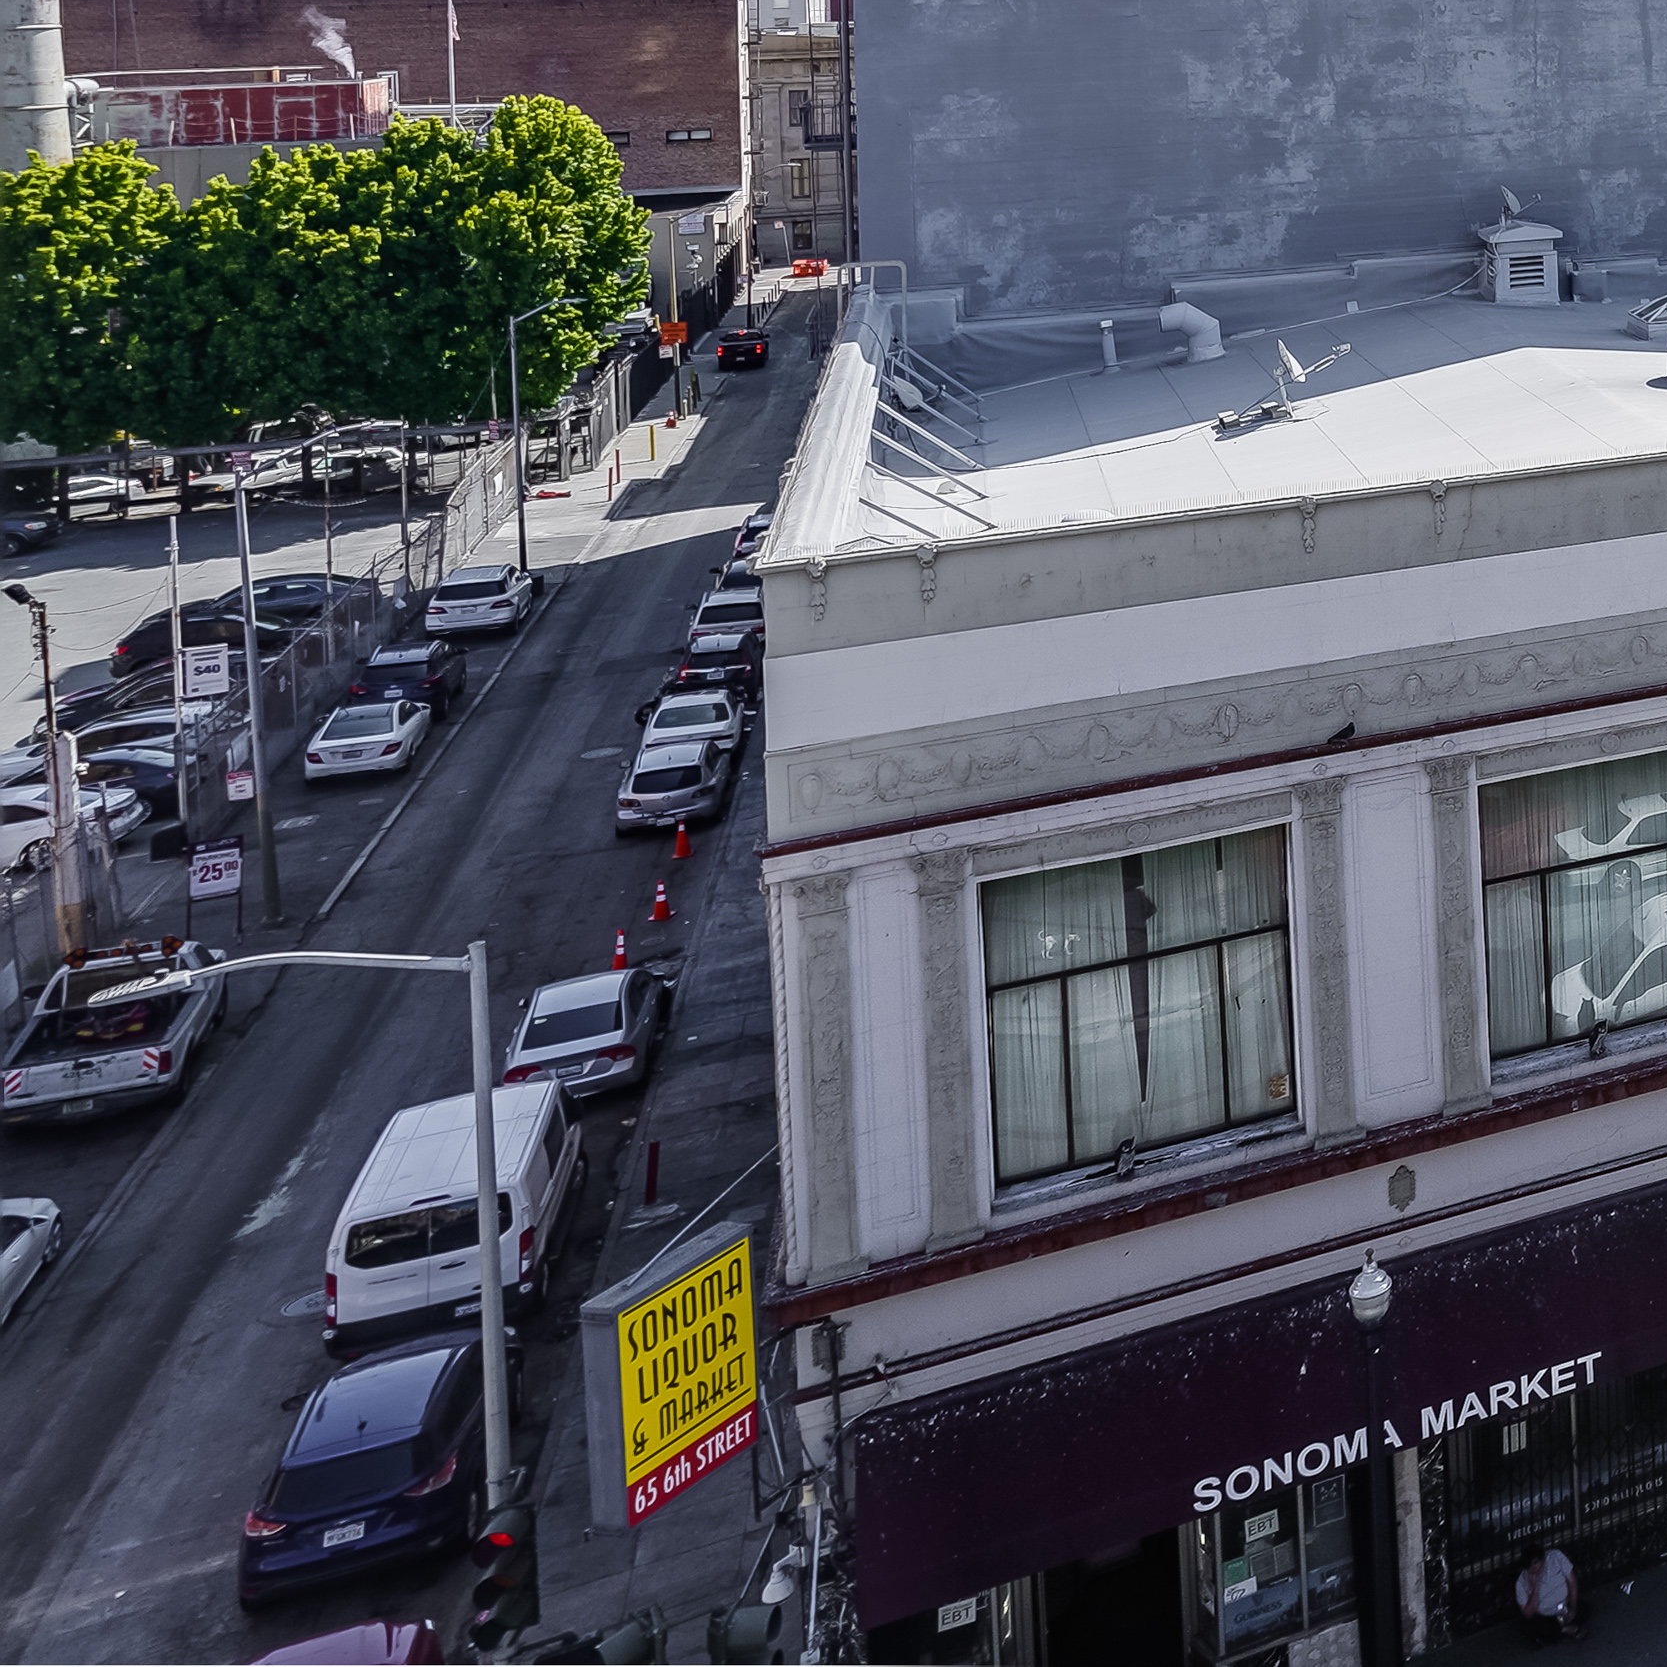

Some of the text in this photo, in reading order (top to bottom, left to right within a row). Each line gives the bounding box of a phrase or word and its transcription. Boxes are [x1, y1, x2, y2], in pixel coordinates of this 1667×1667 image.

[627, 1257, 743, 1363] SONOMA
[632, 1351, 746, 1457] & MARKET
[638, 1312, 738, 1405] LIQUOR
[1420, 1351, 1602, 1439] MARKET
[634, 1411, 752, 1514] 65 6th STREET
[1248, 1517, 1275, 1537] EBT
[942, 1605, 974, 1626] EBT
